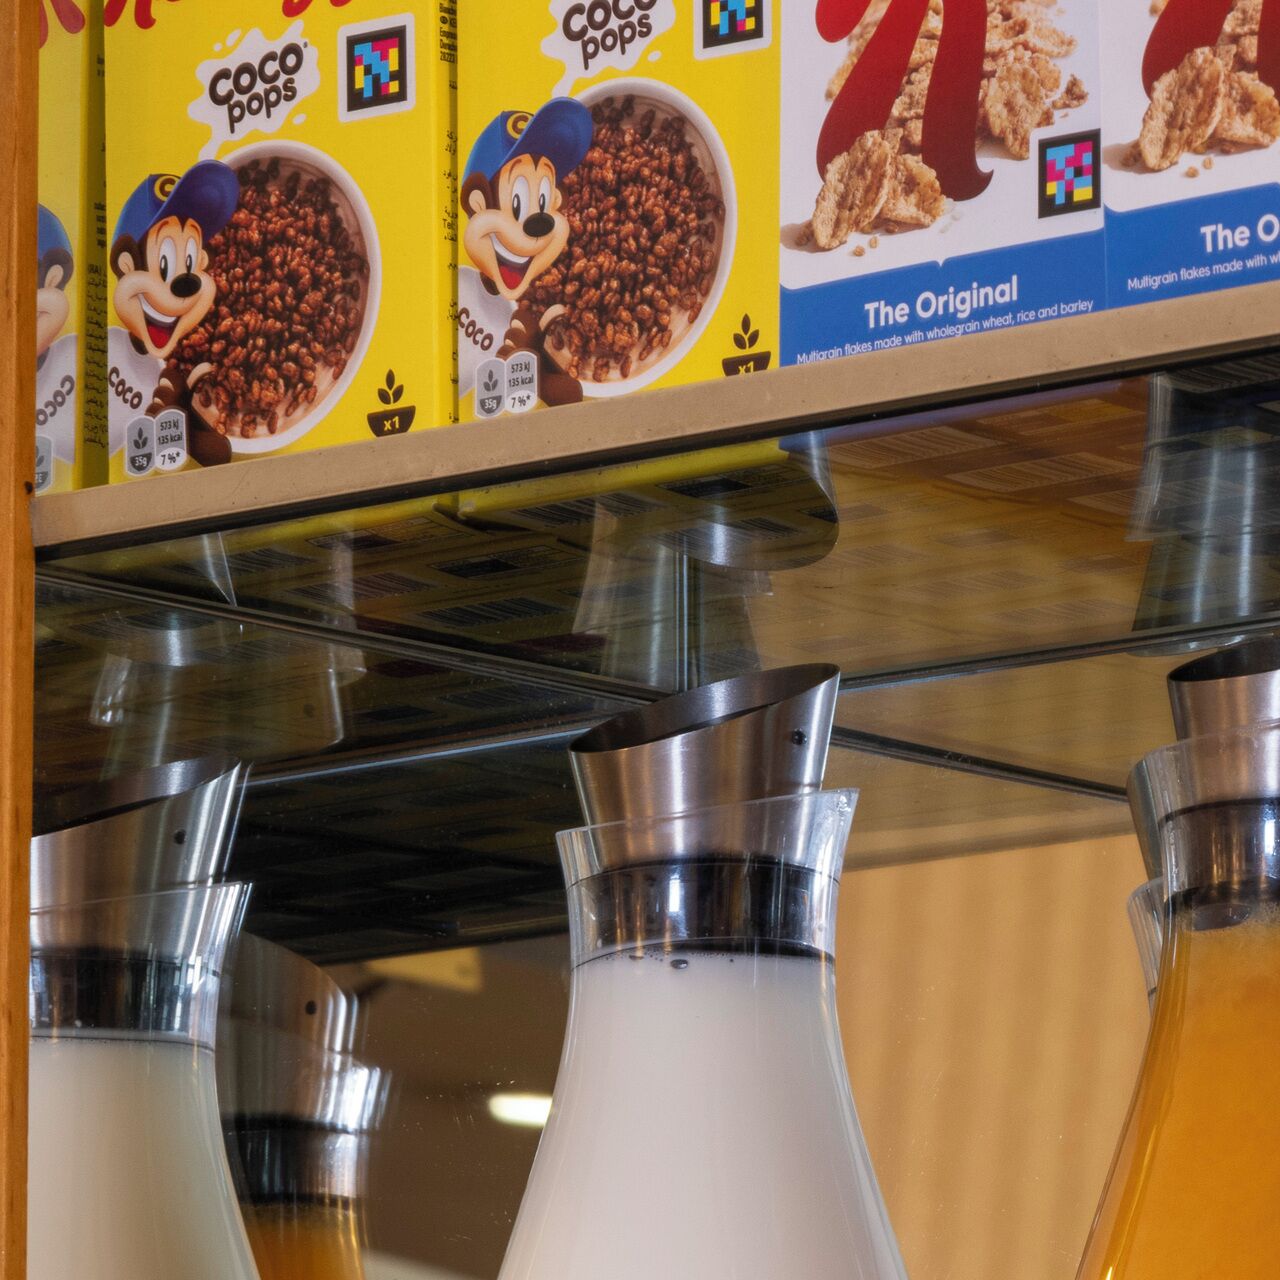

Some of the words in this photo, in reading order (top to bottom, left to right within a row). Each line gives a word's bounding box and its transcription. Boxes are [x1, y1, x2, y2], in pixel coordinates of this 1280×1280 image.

[581, 13, 652, 71] pops
[228, 77, 297, 134] pops
[1200, 222, 1250, 253] The
[1127, 272, 1178, 291] Multigrain
[1180, 263, 1211, 281] flakes
[1213, 258, 1243, 275] made
[1245, 252, 1267, 269] with
[864, 300, 909, 329] The
[915, 275, 1018, 320] Original
[844, 339, 873, 354] flakes
[874, 334, 902, 349] made
[904, 328, 924, 344] with
[926, 320, 980, 340] wholegrain
[982, 313, 1015, 328] wheat,
[1017, 309, 1036, 323] rice
[1037, 303, 1058, 319] and
[1060, 298, 1094, 314] barley
[511, 363, 522, 373] 573
[508, 378, 520, 388] 135
[520, 375, 534, 386] kcal
[484, 399, 497, 410] 35g
[160, 420, 172, 431] 573
[383, 415, 400, 432] x1
[158, 435, 169, 446] 135
[170, 431, 183, 443] kcal
[134, 456, 148, 467] 35g
